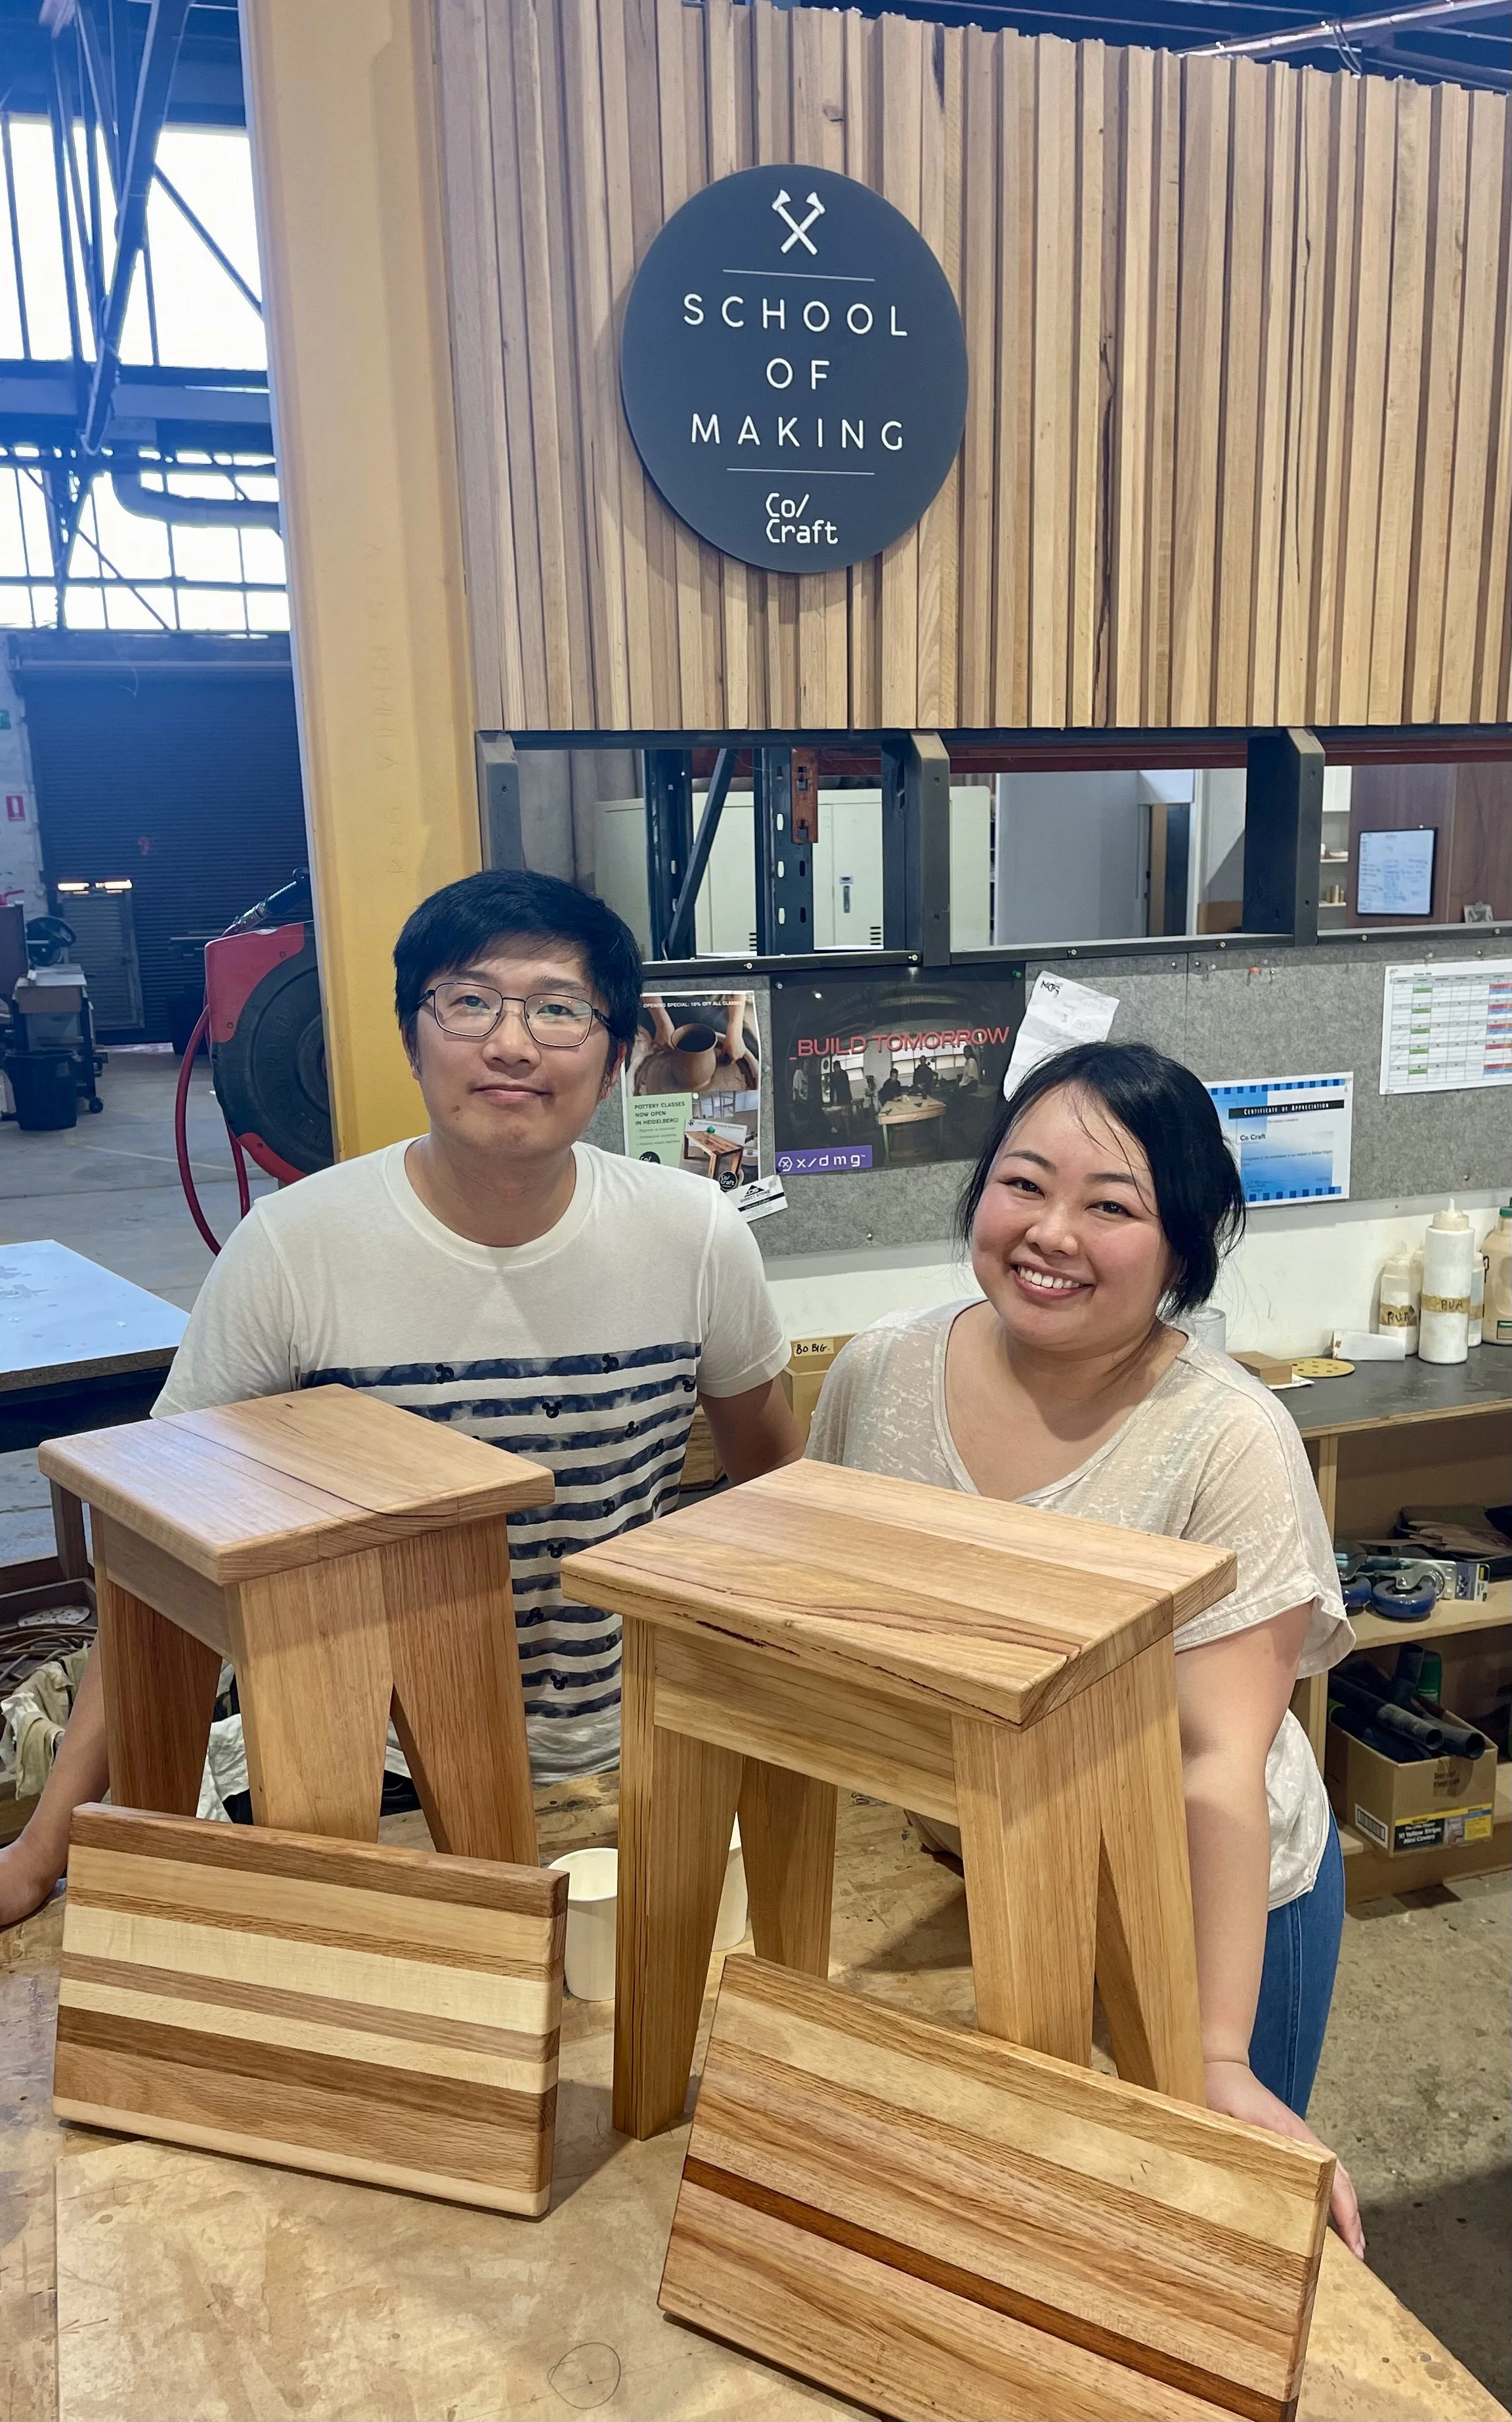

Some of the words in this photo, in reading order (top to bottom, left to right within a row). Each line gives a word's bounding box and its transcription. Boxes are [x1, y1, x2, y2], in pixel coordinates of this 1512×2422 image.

[683, 293, 908, 337] SCHOOL
[766, 357, 831, 390] OF
[691, 412, 904, 451] MAKING
[765, 492, 810, 519] Co/
[765, 519, 839, 544] Craft
[871, 1026, 1010, 1053] TOMORROW
[1440, 1299, 1464, 1310] PVA
[811, 1343, 827, 1352] BIG
